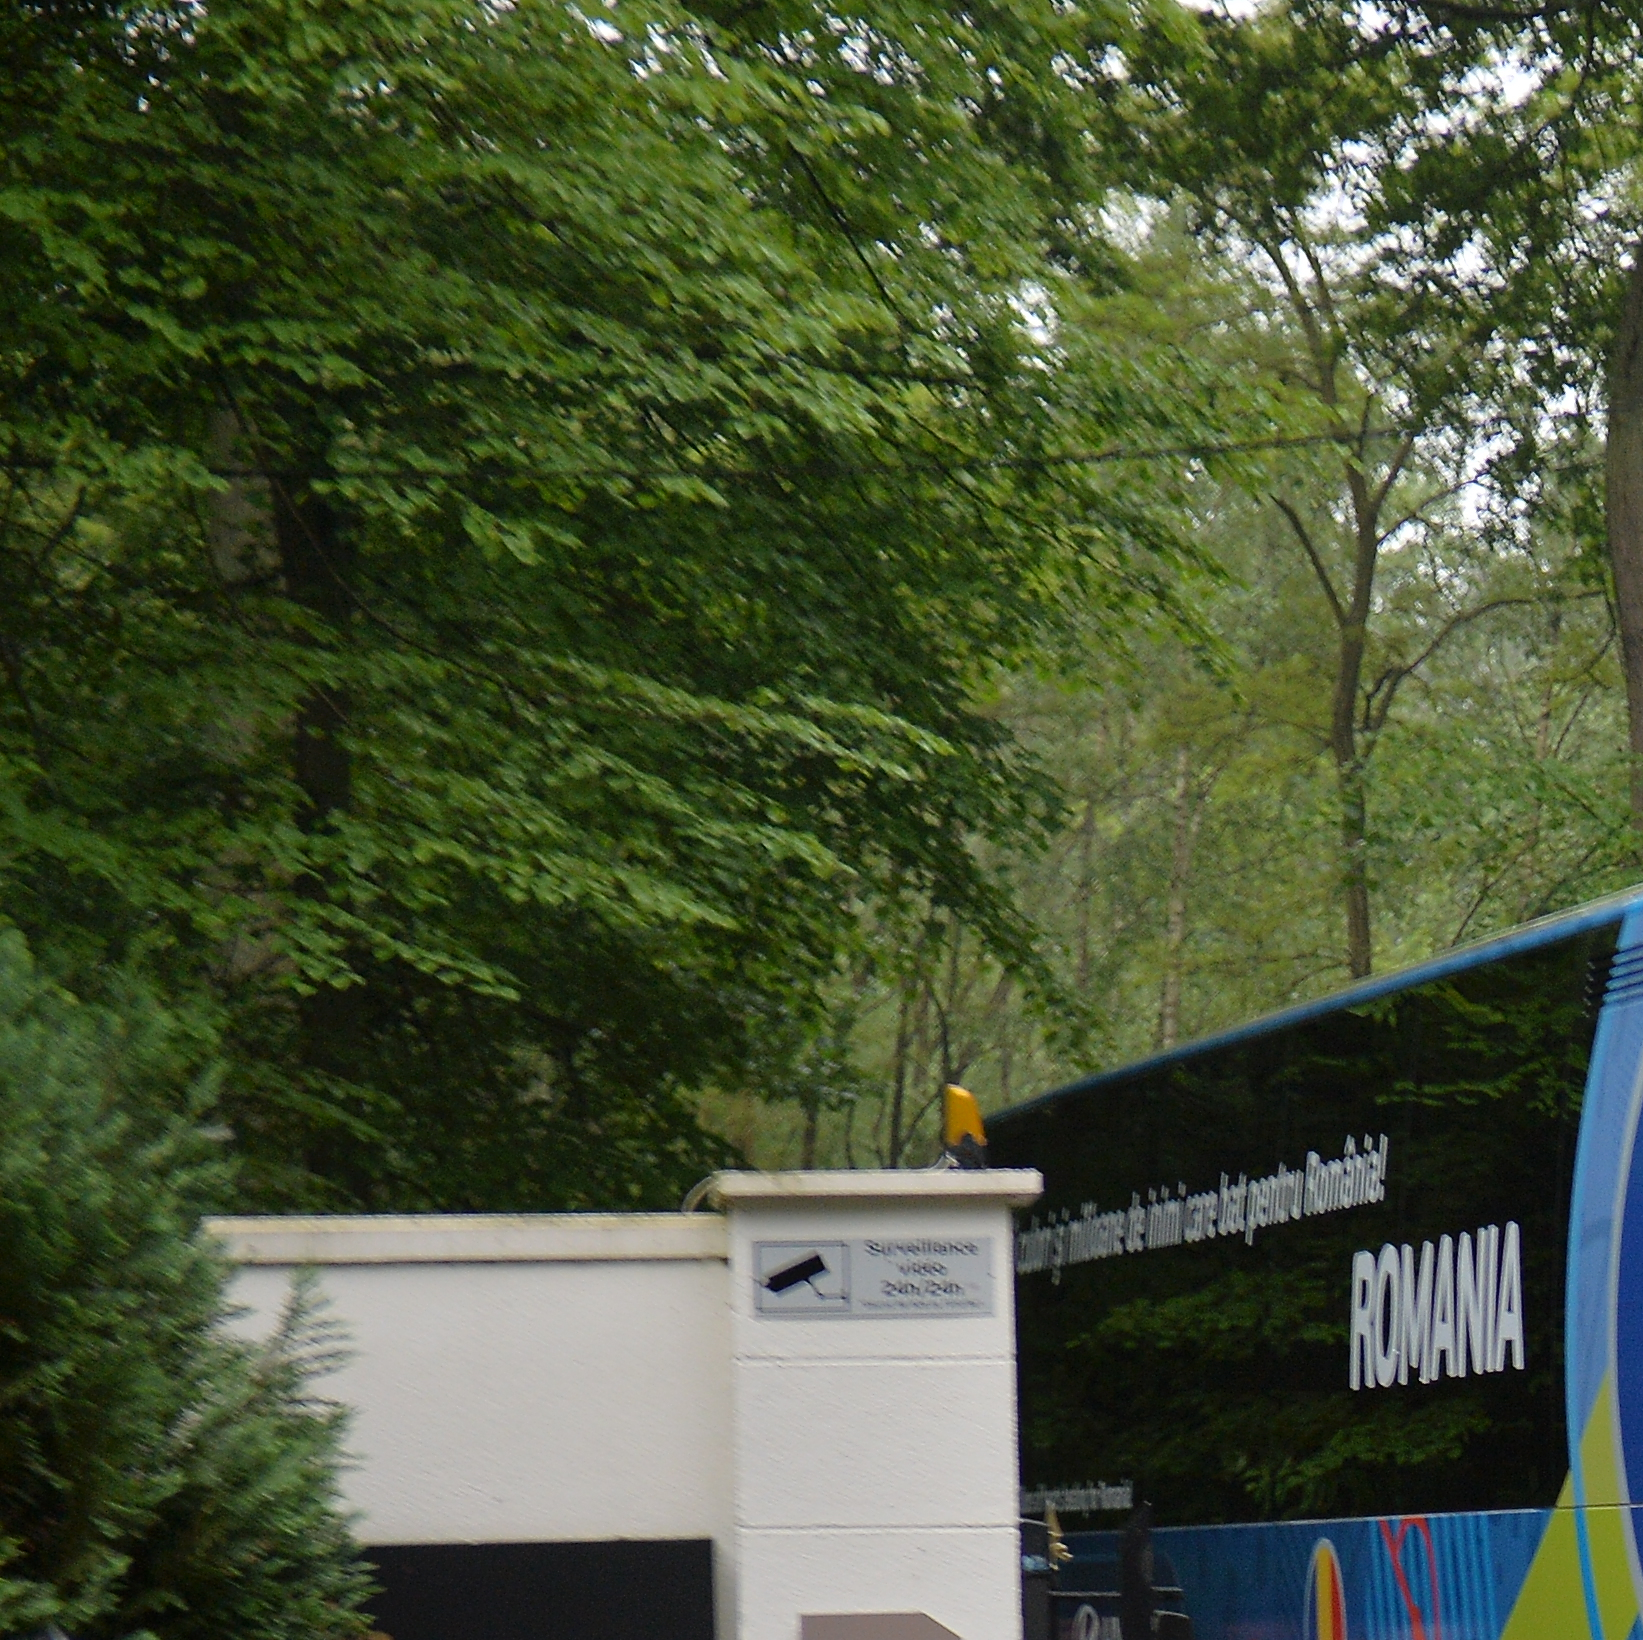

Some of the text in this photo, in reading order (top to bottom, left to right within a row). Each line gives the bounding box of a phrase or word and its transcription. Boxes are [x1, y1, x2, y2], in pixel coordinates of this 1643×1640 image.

[1184, 1190, 1218, 1245] care
[1218, 1171, 1246, 1237] bat
[1245, 1161, 1303, 1246] pentru
[1303, 1132, 1389, 1216] România!
[863, 1239, 980, 1257] Surveillance
[1350, 1220, 1525, 1391] ROMANIA
